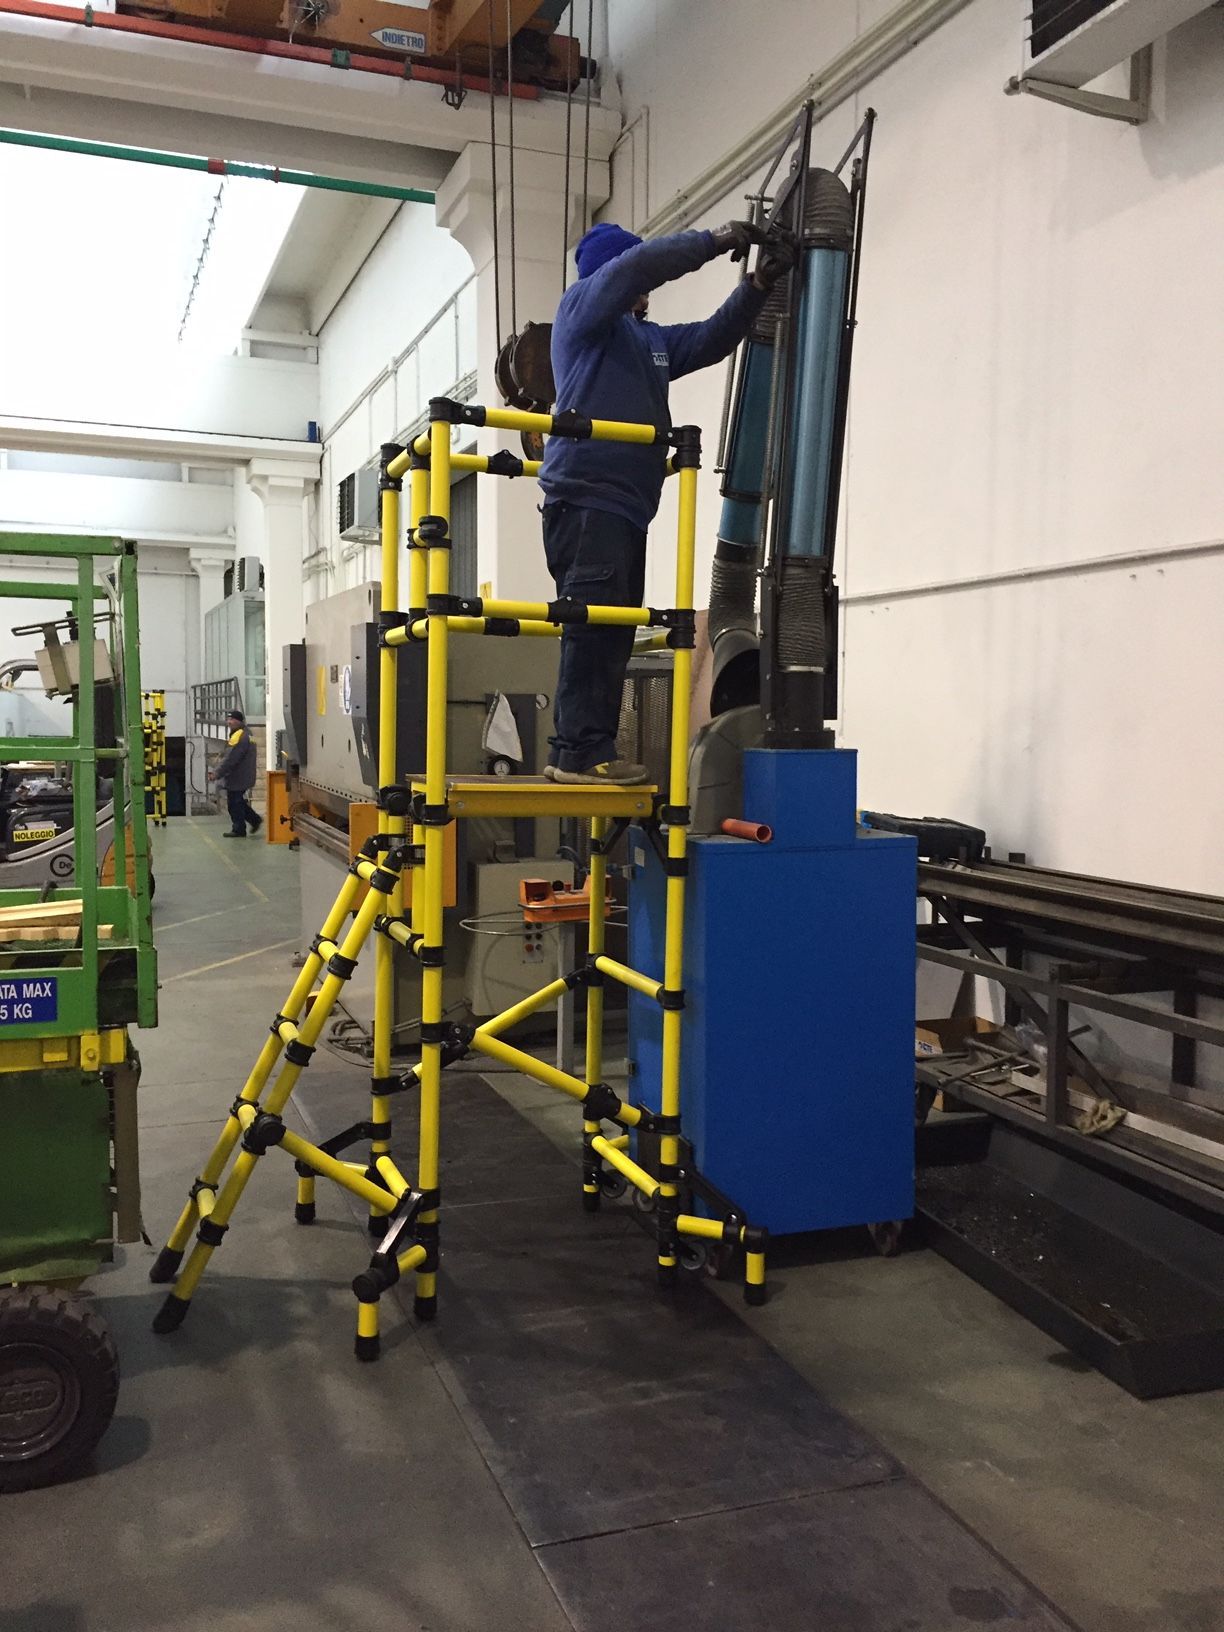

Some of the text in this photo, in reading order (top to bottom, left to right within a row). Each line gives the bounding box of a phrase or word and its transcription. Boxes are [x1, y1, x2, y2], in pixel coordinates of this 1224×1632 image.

[382, 31, 424, 49] INDIETRO
[15, 830, 54, 840] NOLEGGIO
[22, 982, 52, 999] MAX
[13, 1003, 33, 1019] KG
